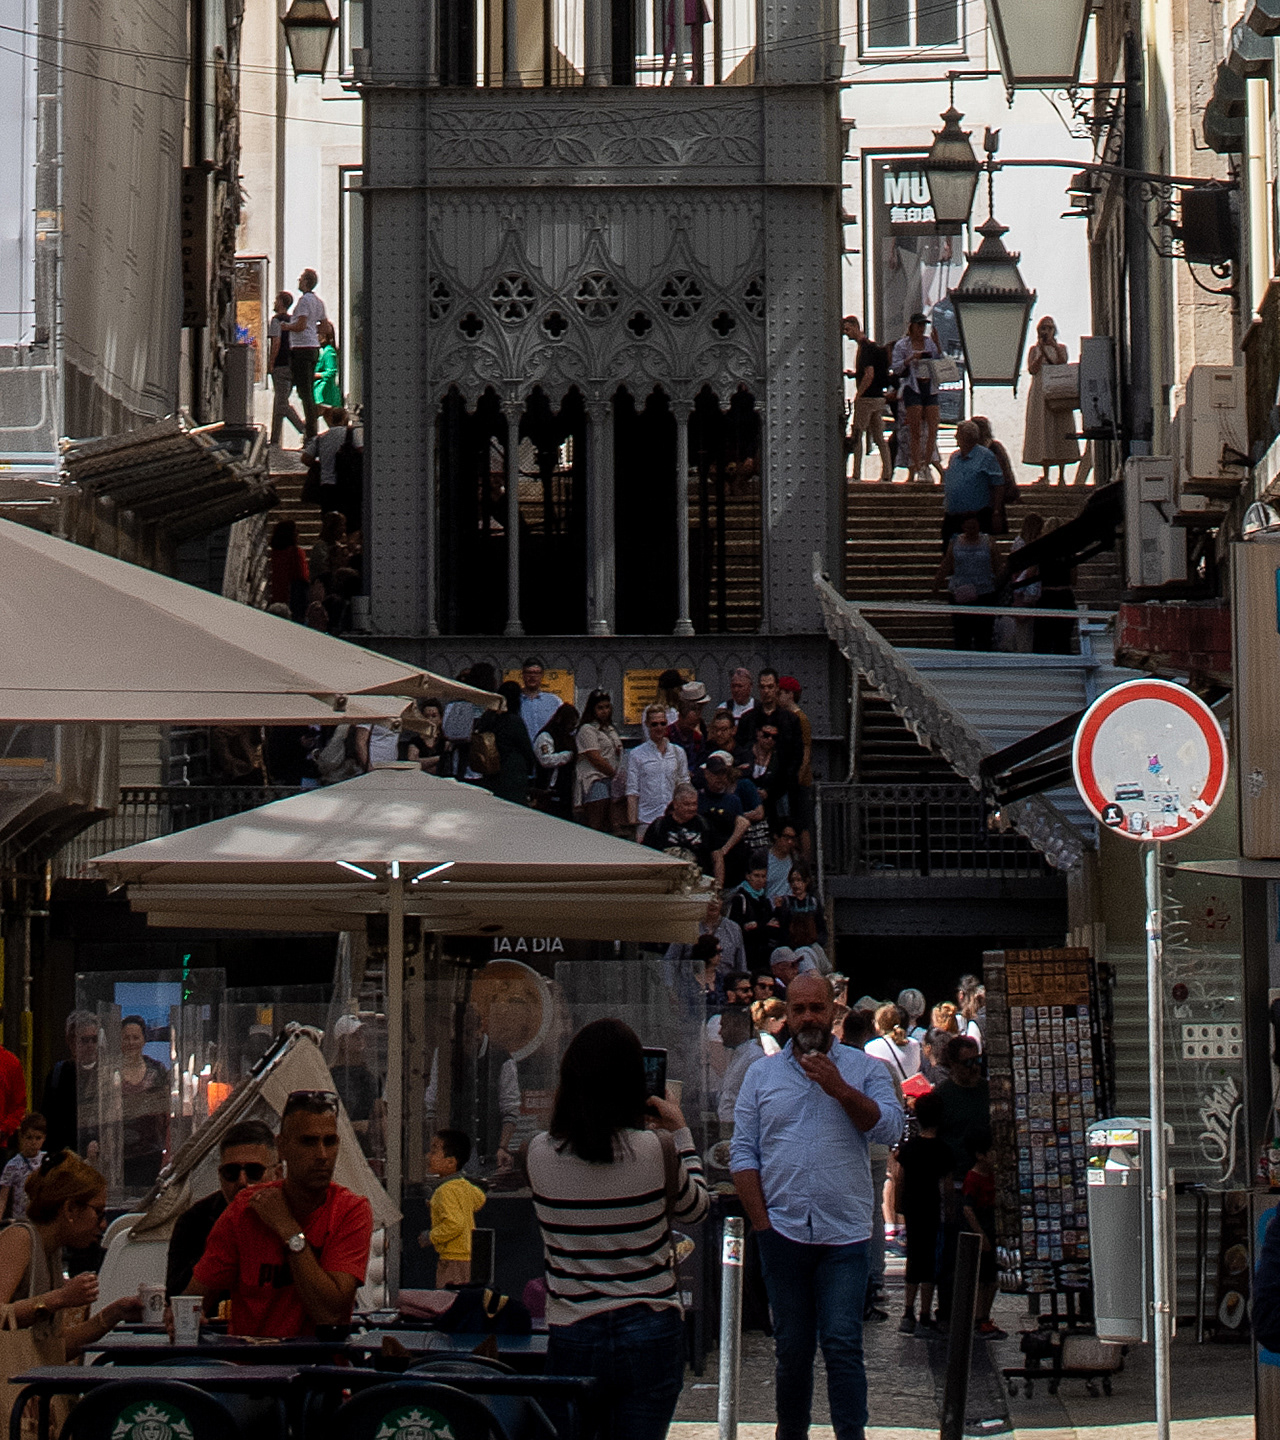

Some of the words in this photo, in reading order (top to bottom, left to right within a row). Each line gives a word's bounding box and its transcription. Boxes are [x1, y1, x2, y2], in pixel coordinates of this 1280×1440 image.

[884, 171, 931, 204] MU
[890, 205, 936, 223] 無印良
[532, 936, 565, 953] DIA
